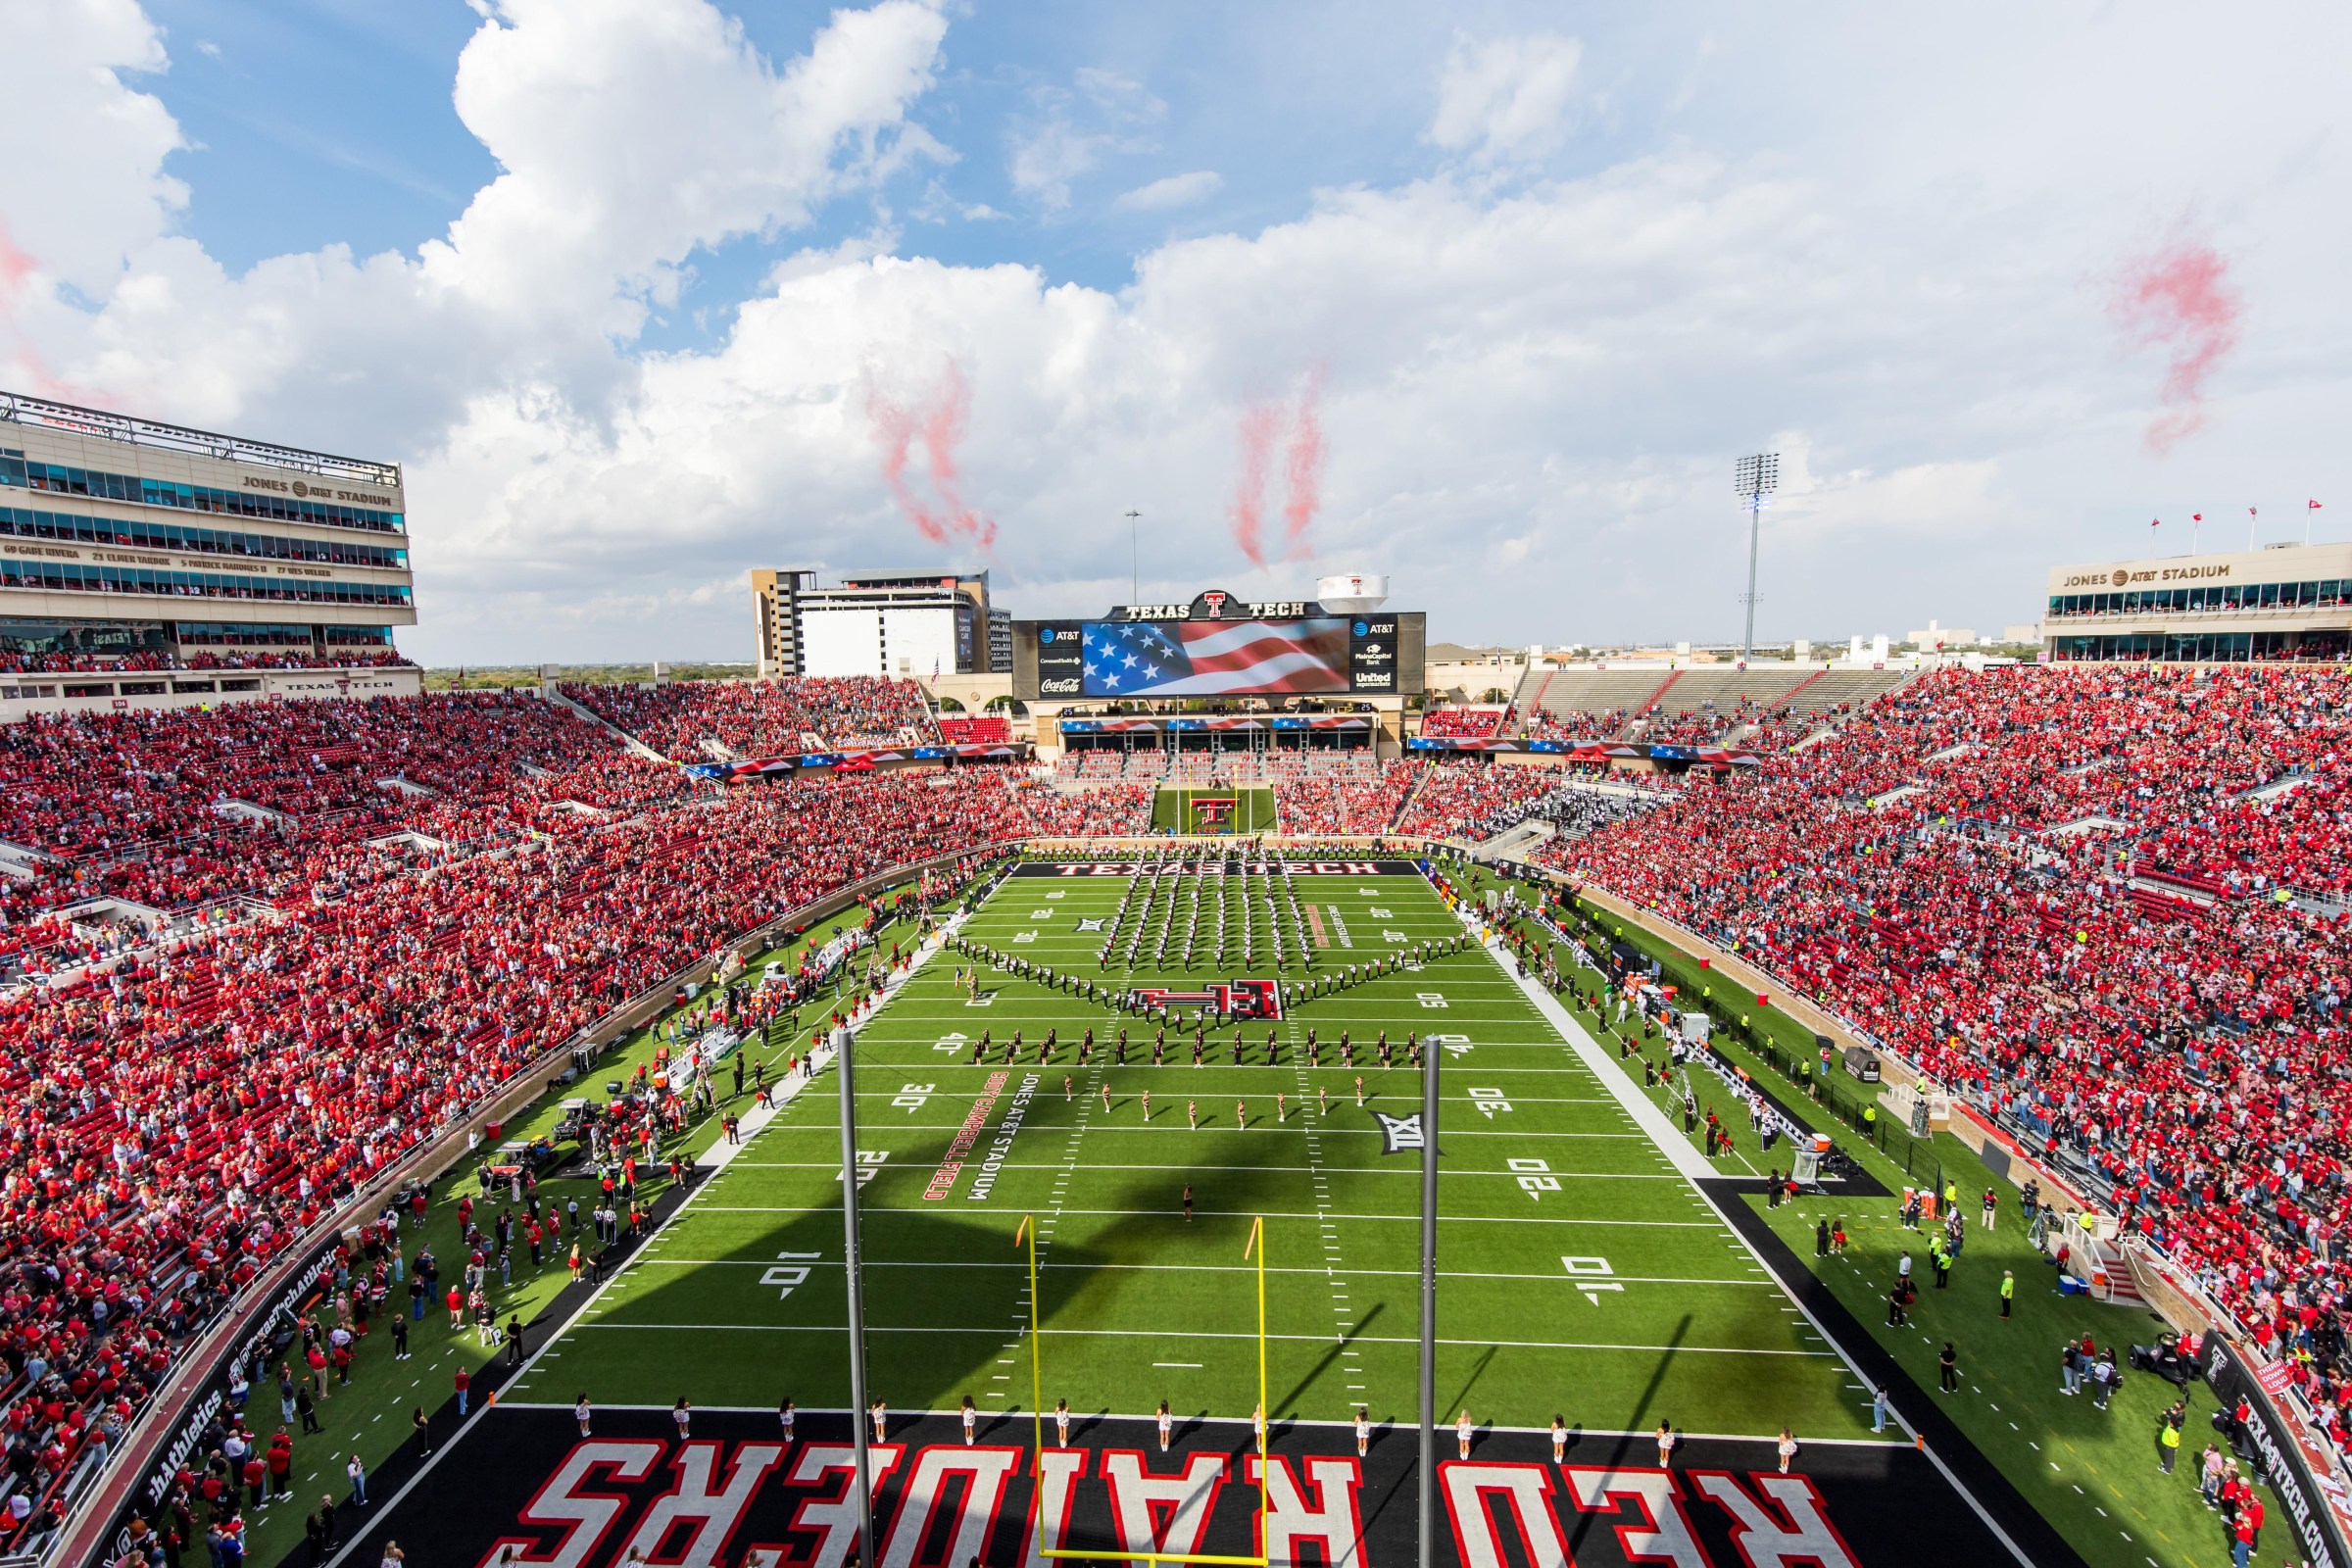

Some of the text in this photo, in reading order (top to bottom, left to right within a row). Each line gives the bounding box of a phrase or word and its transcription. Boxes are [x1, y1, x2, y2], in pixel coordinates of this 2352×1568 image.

[244, 476, 391, 506] JONES AT&T STADIUM
[19, 546, 43, 556] GABE
[45, 548, 79, 559] RIVERA
[107, 554, 136, 564] ELMER
[137, 556, 171, 565] TARBOX
[189, 561, 220, 569] PATRICK
[223, 563, 259, 572] MAHOMES
[304, 568, 331, 577] WELKER
[2064, 564, 2230, 587] JONES AT&T STADIUM
[1127, 605, 1190, 619] TEXAS
[1249, 603, 1304, 617] TECH
[1056, 631, 1079, 640] AT&T
[1370, 624, 1394, 633] AT&T
[1356, 672, 1391, 682] United
[1041, 678, 1081, 692] Coca-Cola
[1054, 862, 1380, 876] TEXAS TECH
[1416, 994, 1448, 1007] 50
[933, 1032, 968, 1051] 40
[1440, 1035, 1474, 1054] 40
[890, 1083, 936, 1107] 30
[1468, 1088, 1513, 1112] 30
[923, 1071, 1009, 1200] CODY CAMPBELL FIELD
[965, 1072, 1042, 1200] JONES AT&T STADIUM
[837, 1151, 890, 1183] 20
[1505, 1158, 1562, 1191] 20
[759, 1251, 821, 1286] 10
[1560, 1256, 1625, 1292] 10
[2257, 1360, 2281, 1375] THIRD
[2262, 1367, 2285, 1382] DOWN
[2268, 1375, 2288, 1389] LOUD
[474, 1437, 1870, 1568] RED RAIDERS
